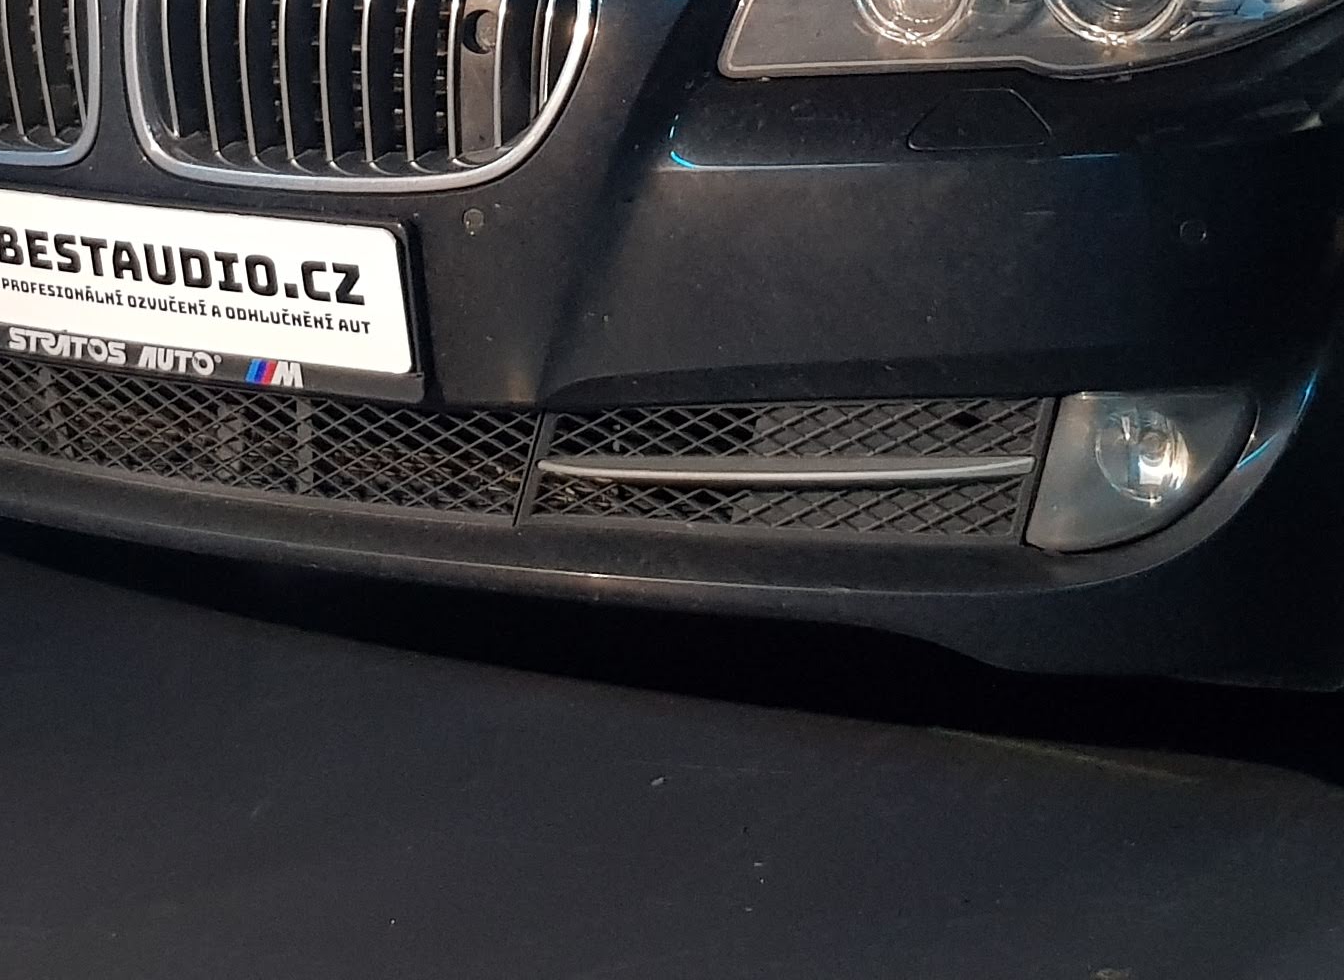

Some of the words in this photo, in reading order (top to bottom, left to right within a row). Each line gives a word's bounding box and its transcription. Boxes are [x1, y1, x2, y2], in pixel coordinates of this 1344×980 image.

[1, 277, 124, 306] PROFESIONÁLNÍ
[127, 295, 208, 316] OZVUČENÍ
[211, 305, 222, 318] A
[225, 307, 334, 331] ODHLUČNĚNÍ
[338, 318, 370, 335] AUT
[8, 326, 127, 366] STRATOS
[138, 346, 215, 376] AUTO
[271, 360, 304, 389] M
